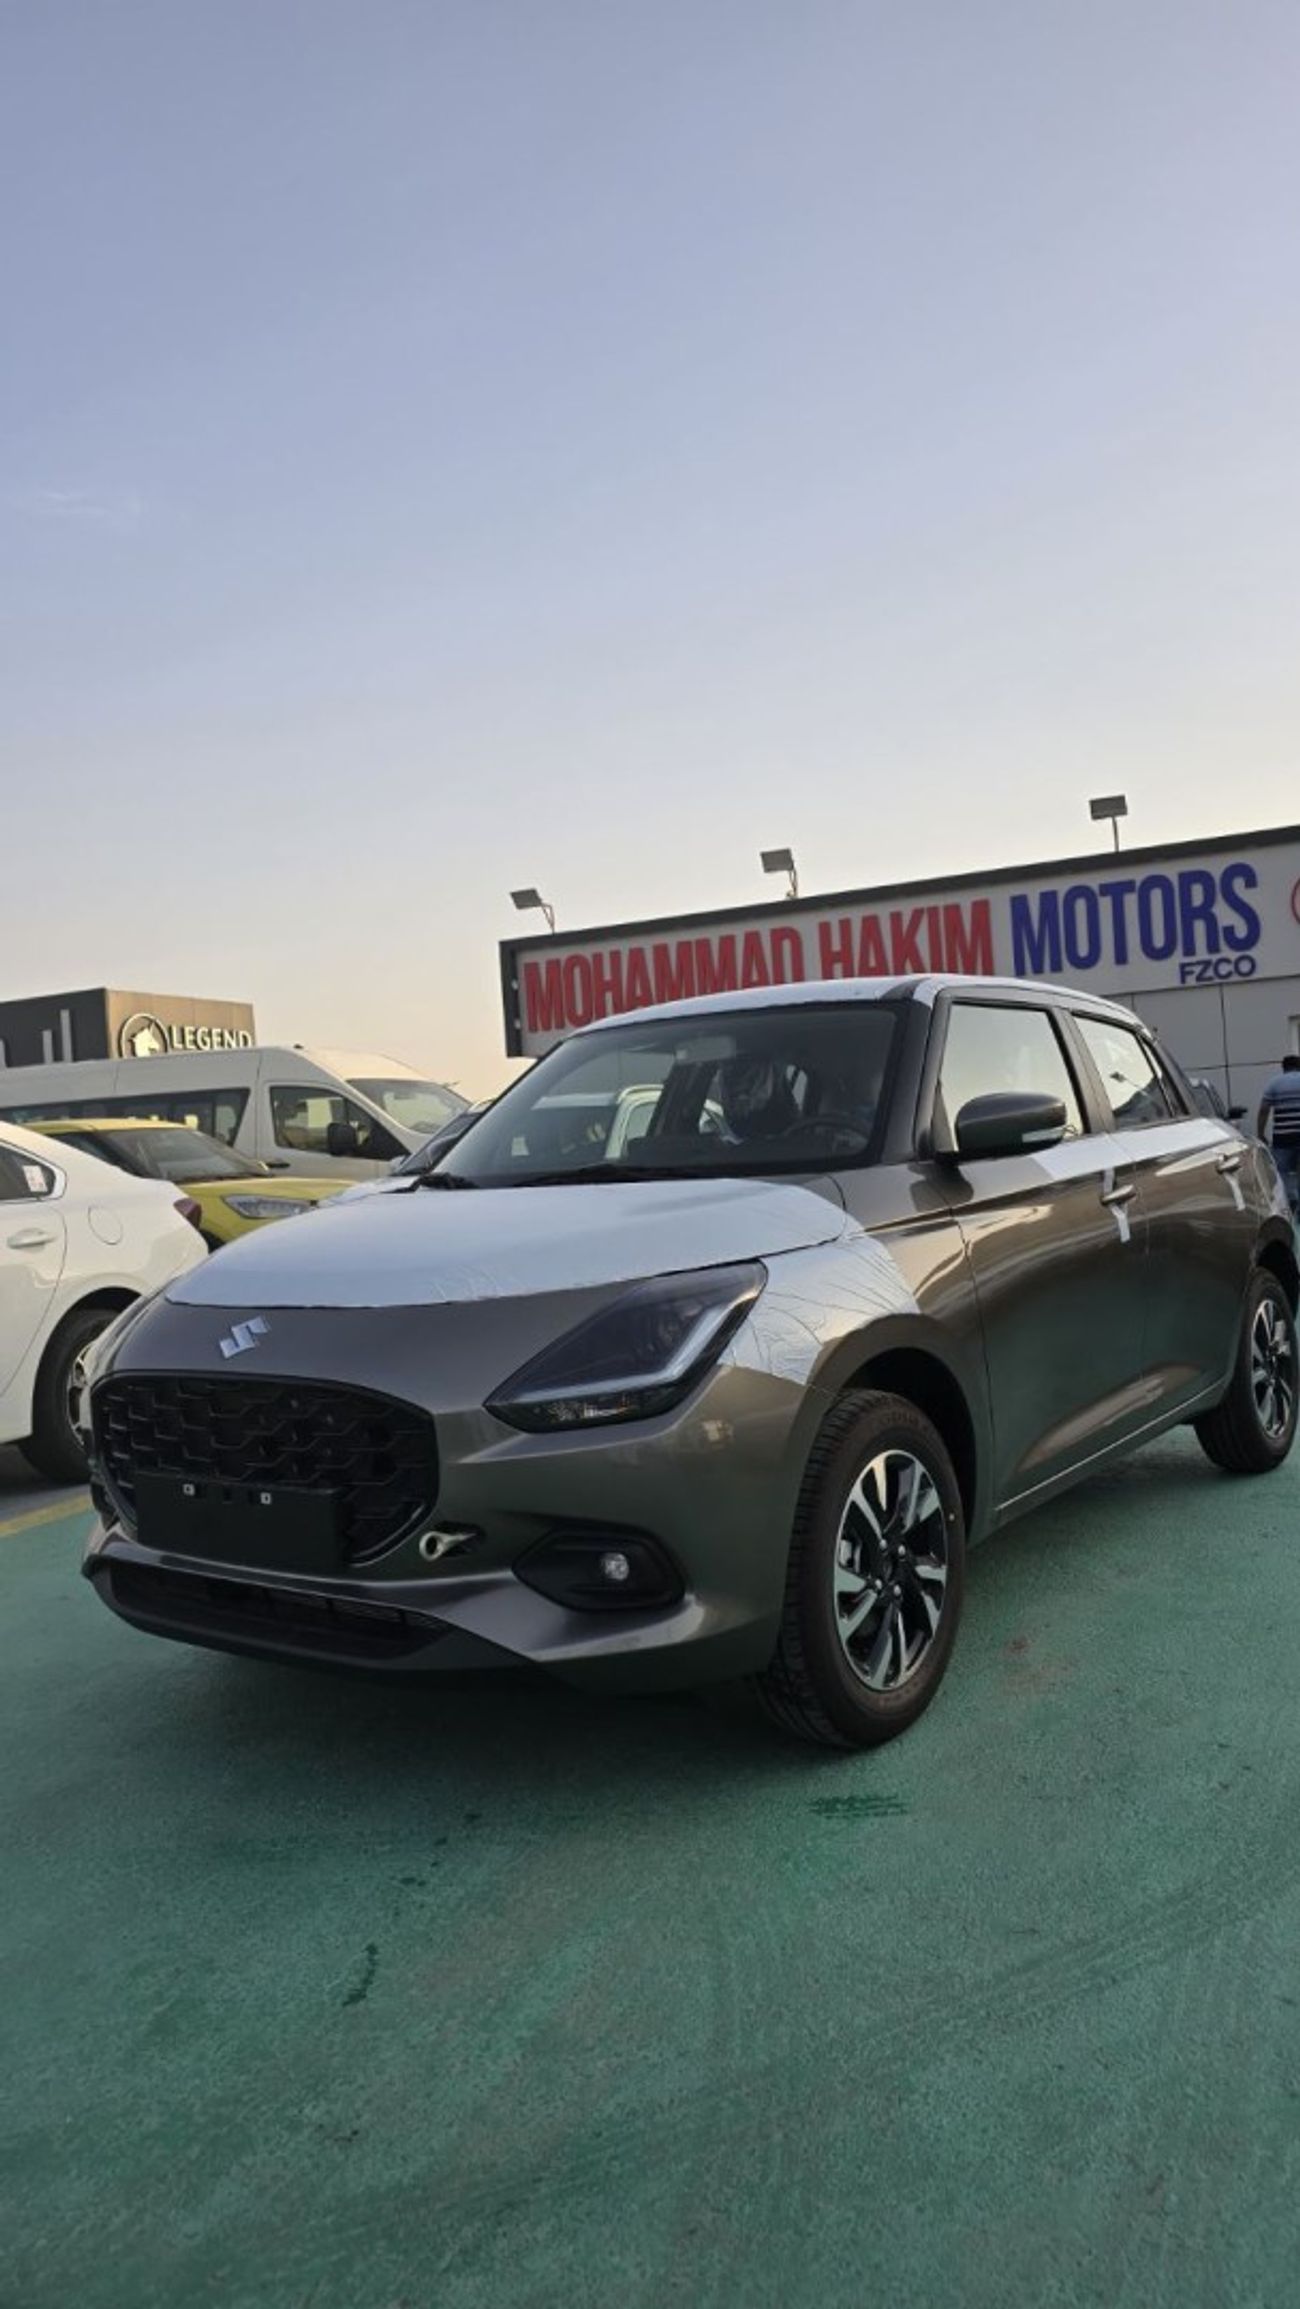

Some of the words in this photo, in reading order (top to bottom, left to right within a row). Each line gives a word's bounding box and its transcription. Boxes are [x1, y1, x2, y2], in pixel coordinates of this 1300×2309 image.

[524, 926, 805, 1033] MOHAMMAD
[819, 899, 995, 979] HAKIM
[1010, 862, 1261, 977] MOTORS
[1179, 954, 1257, 984] FZCO
[172, 1025, 252, 1051] LEGEND
